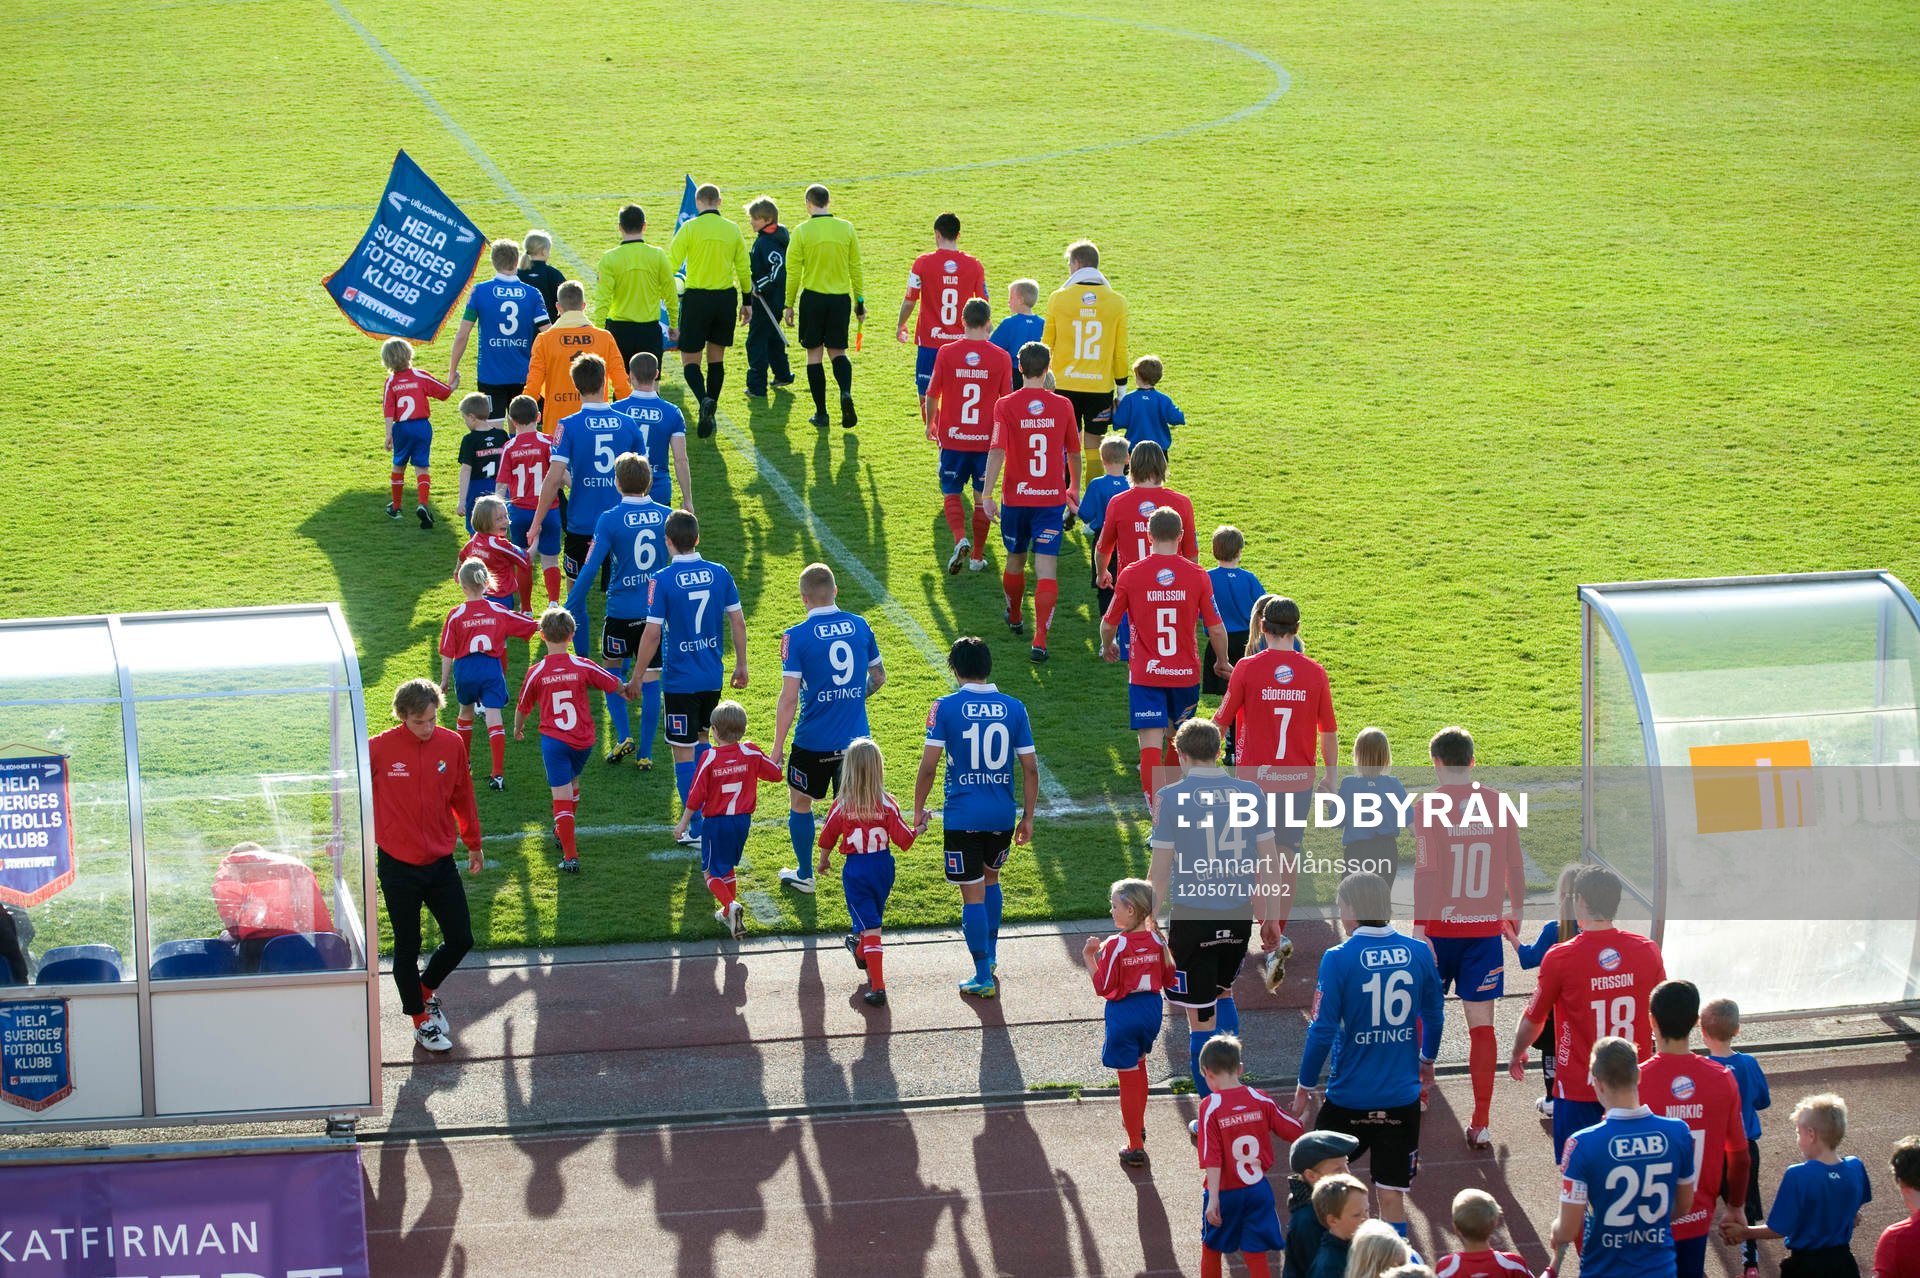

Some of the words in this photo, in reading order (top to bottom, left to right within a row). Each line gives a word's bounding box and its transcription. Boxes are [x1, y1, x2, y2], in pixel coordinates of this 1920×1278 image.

[401, 215, 447, 251] HELA
[374, 224, 456, 278] SVERIGES
[362, 240, 447, 295] FOTBOLLS
[362, 265, 420, 305] KLUBB
[496, 287, 524, 297] EAB
[941, 288, 959, 325] 8
[499, 301, 519, 335] 3
[489, 338, 528, 348] GETINGE
[563, 335, 592, 345] EAB
[1072, 320, 1103, 360] 12
[397, 395, 416, 422] 2
[630, 407, 660, 421] EAB
[961, 383, 981, 424] 2
[589, 417, 620, 429] EAB
[1020, 418, 1055, 429] KARLSSON
[594, 433, 615, 474] 5
[1028, 433, 1047, 478] 3
[482, 461, 496, 478] 1
[512, 462, 543, 498] 11
[627, 511, 661, 526] EAB
[633, 529, 657, 571] 6
[679, 570, 712, 586] EAB
[1146, 590, 1186, 601] KARLSSON
[688, 590, 711, 634] 7
[818, 621, 853, 638] EAB
[1156, 608, 1177, 657] 5
[829, 640, 854, 686] 9
[1146, 661, 1193, 676] Fellessons
[818, 686, 862, 703] GETINGE
[1261, 686, 1307, 702] SÖDERBERG
[552, 690, 577, 731] 5
[966, 703, 1004, 718] EAB
[1274, 707, 1293, 760] 7
[962, 722, 1010, 770] 10
[958, 773, 1011, 785] GETINGE
[1257, 766, 1308, 781] Fellessons
[721, 781, 743, 816] 7
[847, 826, 889, 854] 10
[1450, 842, 1492, 899] 10
[1441, 907, 1498, 923] Fellessons
[1123, 956, 1144, 966] TEAM
[1365, 947, 1408, 967] EAB
[1590, 973, 1634, 991] PERSSON
[1362, 969, 1414, 1027] 16
[16, 1014, 47, 1027] HELA
[1590, 995, 1636, 1042] 18
[4, 1027, 62, 1042] SVERIGES
[4, 1042, 62, 1056] FOTBOLLS
[15, 1056, 53, 1069] KLUBB
[1219, 1113, 1242, 1128] TEAM
[1665, 1103, 1704, 1119] NURKIC
[1614, 1135, 1665, 1158] EAB
[1231, 1134, 1264, 1186] 8
[1603, 1162, 1673, 1227] 25
[1601, 1227, 1667, 1249] GETINGE
